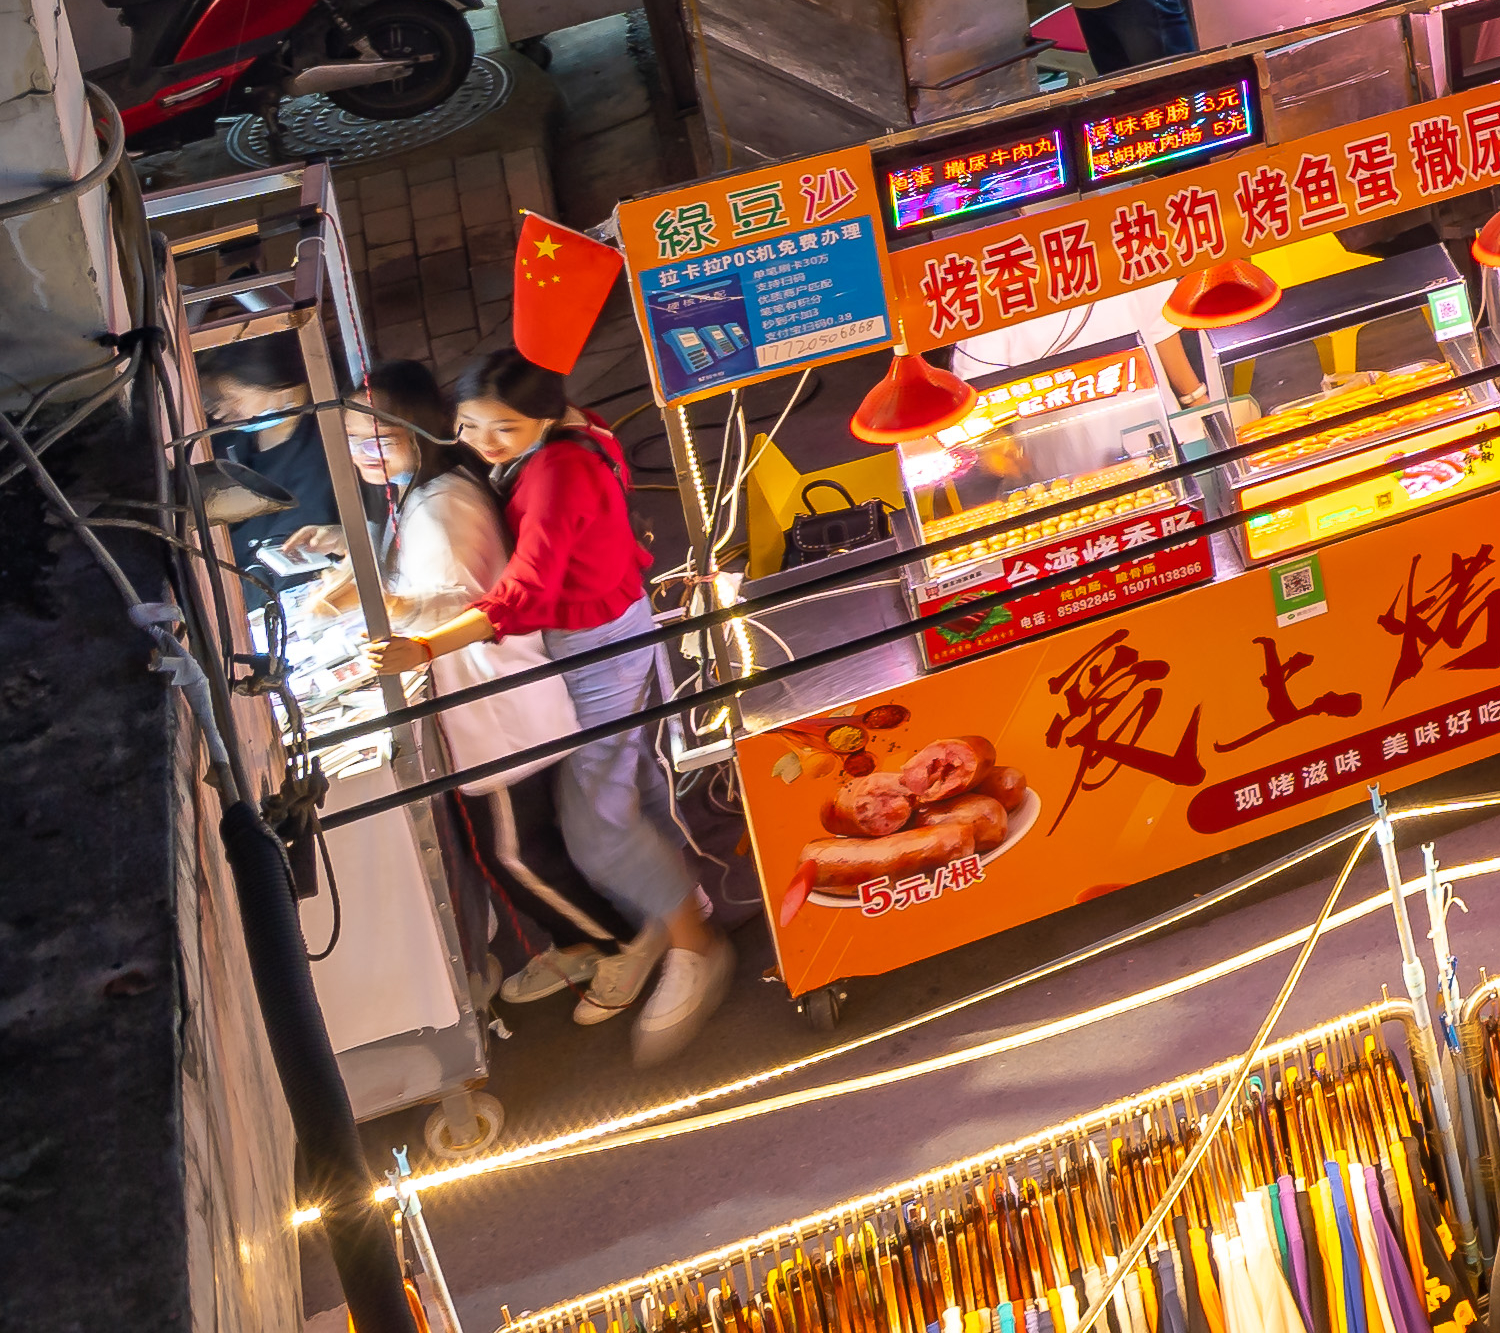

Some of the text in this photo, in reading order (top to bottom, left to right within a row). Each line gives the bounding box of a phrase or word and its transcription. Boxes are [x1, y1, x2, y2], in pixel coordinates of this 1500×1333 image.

[1203, 88, 1241, 113] 3元
[1213, 113, 1248, 136] 5元
[658, 222, 863, 288] 拉卡拉POS机免费办理
[921, 211, 1099, 333] 烤香肠
[1113, 184, 1227, 281] 热狗
[1235, 131, 1401, 241] 烤鱼蛋
[755, 272, 806, 293] 支持扫码
[1056, 590, 1118, 618] 85892845
[1121, 561, 1203, 597] 15071138366
[1233, 747, 1364, 814] 现烤滋味
[859, 849, 985, 918] 5元/根
